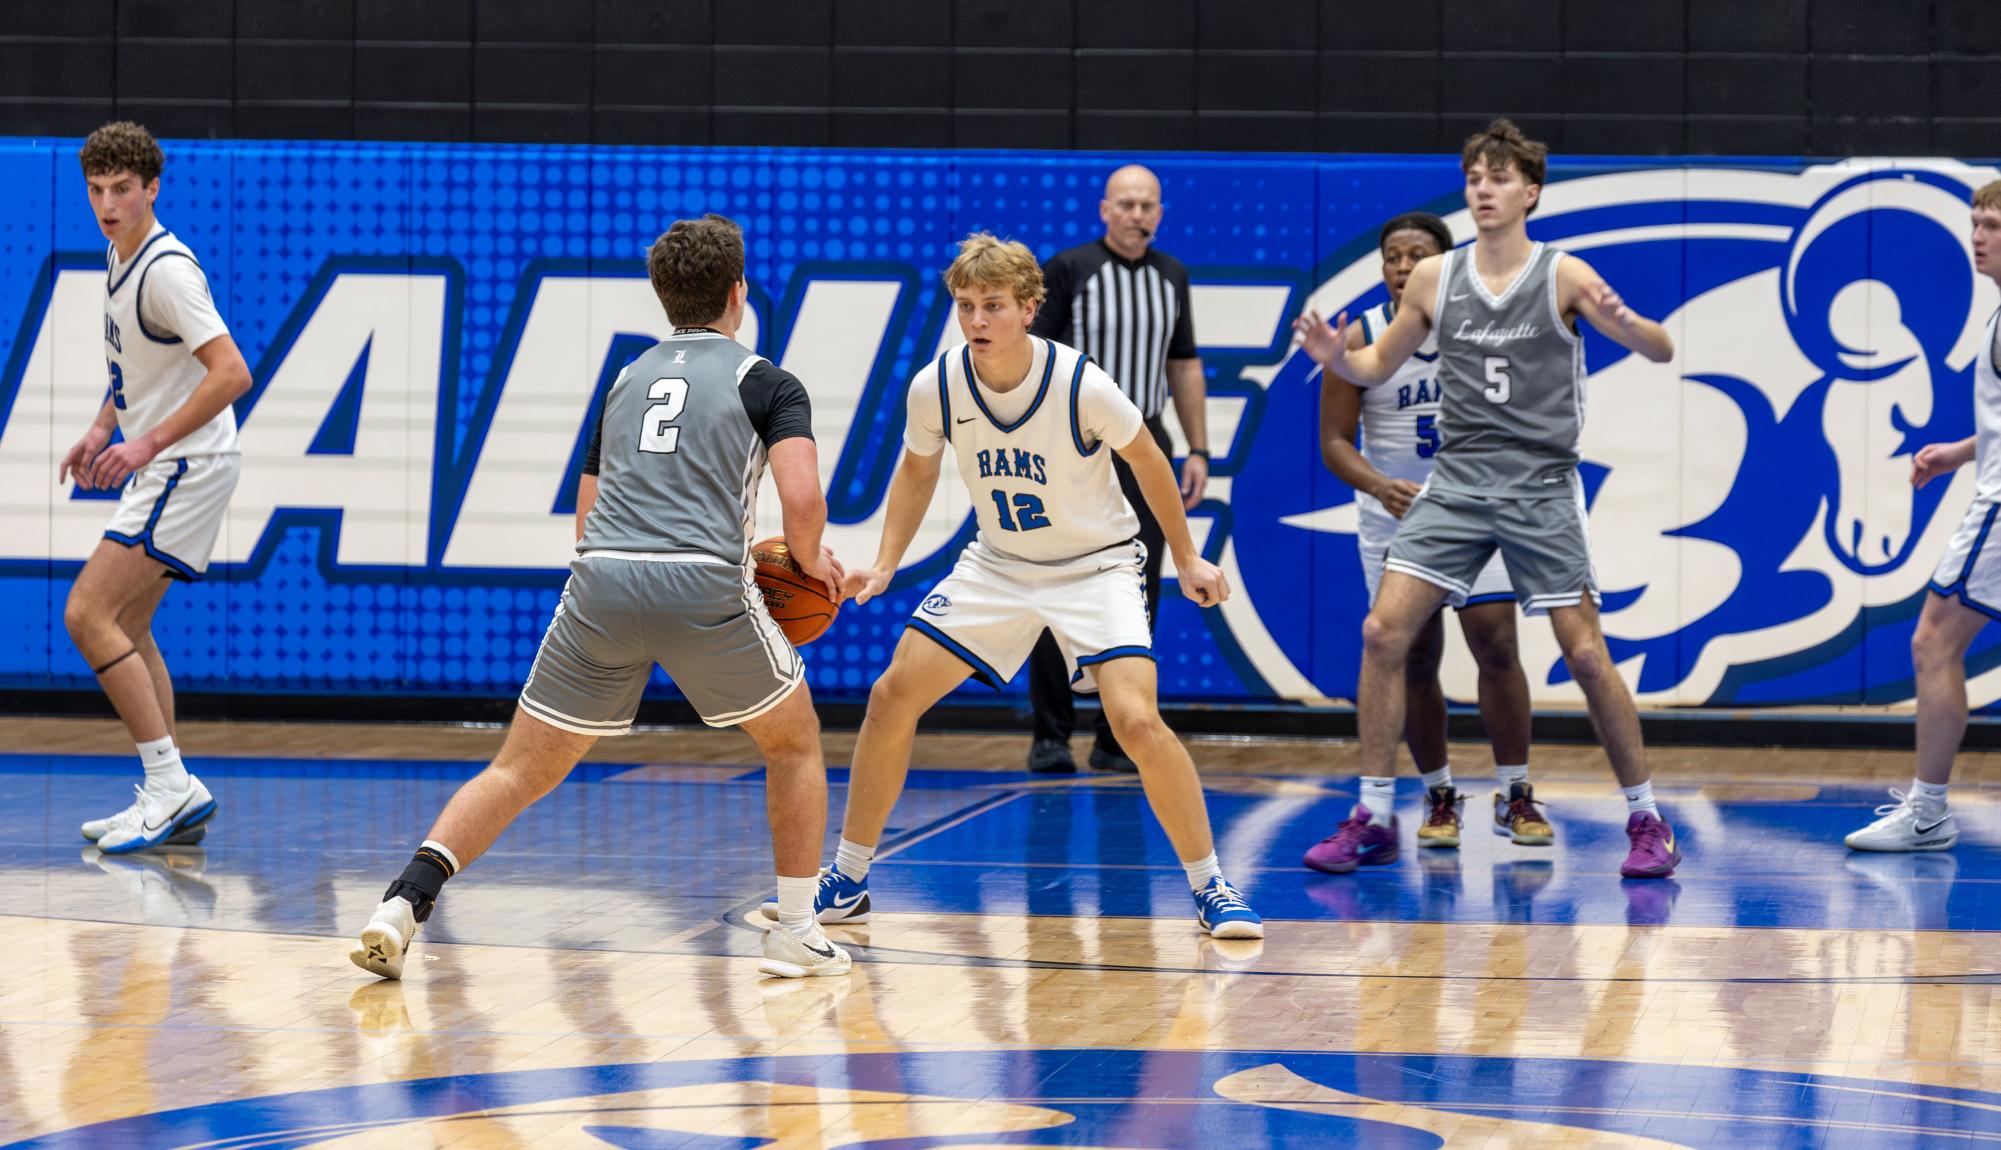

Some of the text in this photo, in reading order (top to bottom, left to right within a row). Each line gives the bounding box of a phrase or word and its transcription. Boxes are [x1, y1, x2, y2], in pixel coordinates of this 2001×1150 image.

[1453, 319, 1540, 347] Lafayette
[106, 356, 127, 410] 2
[1398, 378, 1442, 410] RA
[1484, 354, 1512, 405] 5
[637, 377, 690, 454] 2
[1416, 415, 1442, 458] 5
[977, 448, 1047, 485] RAMS
[991, 489, 1052, 532] 12
